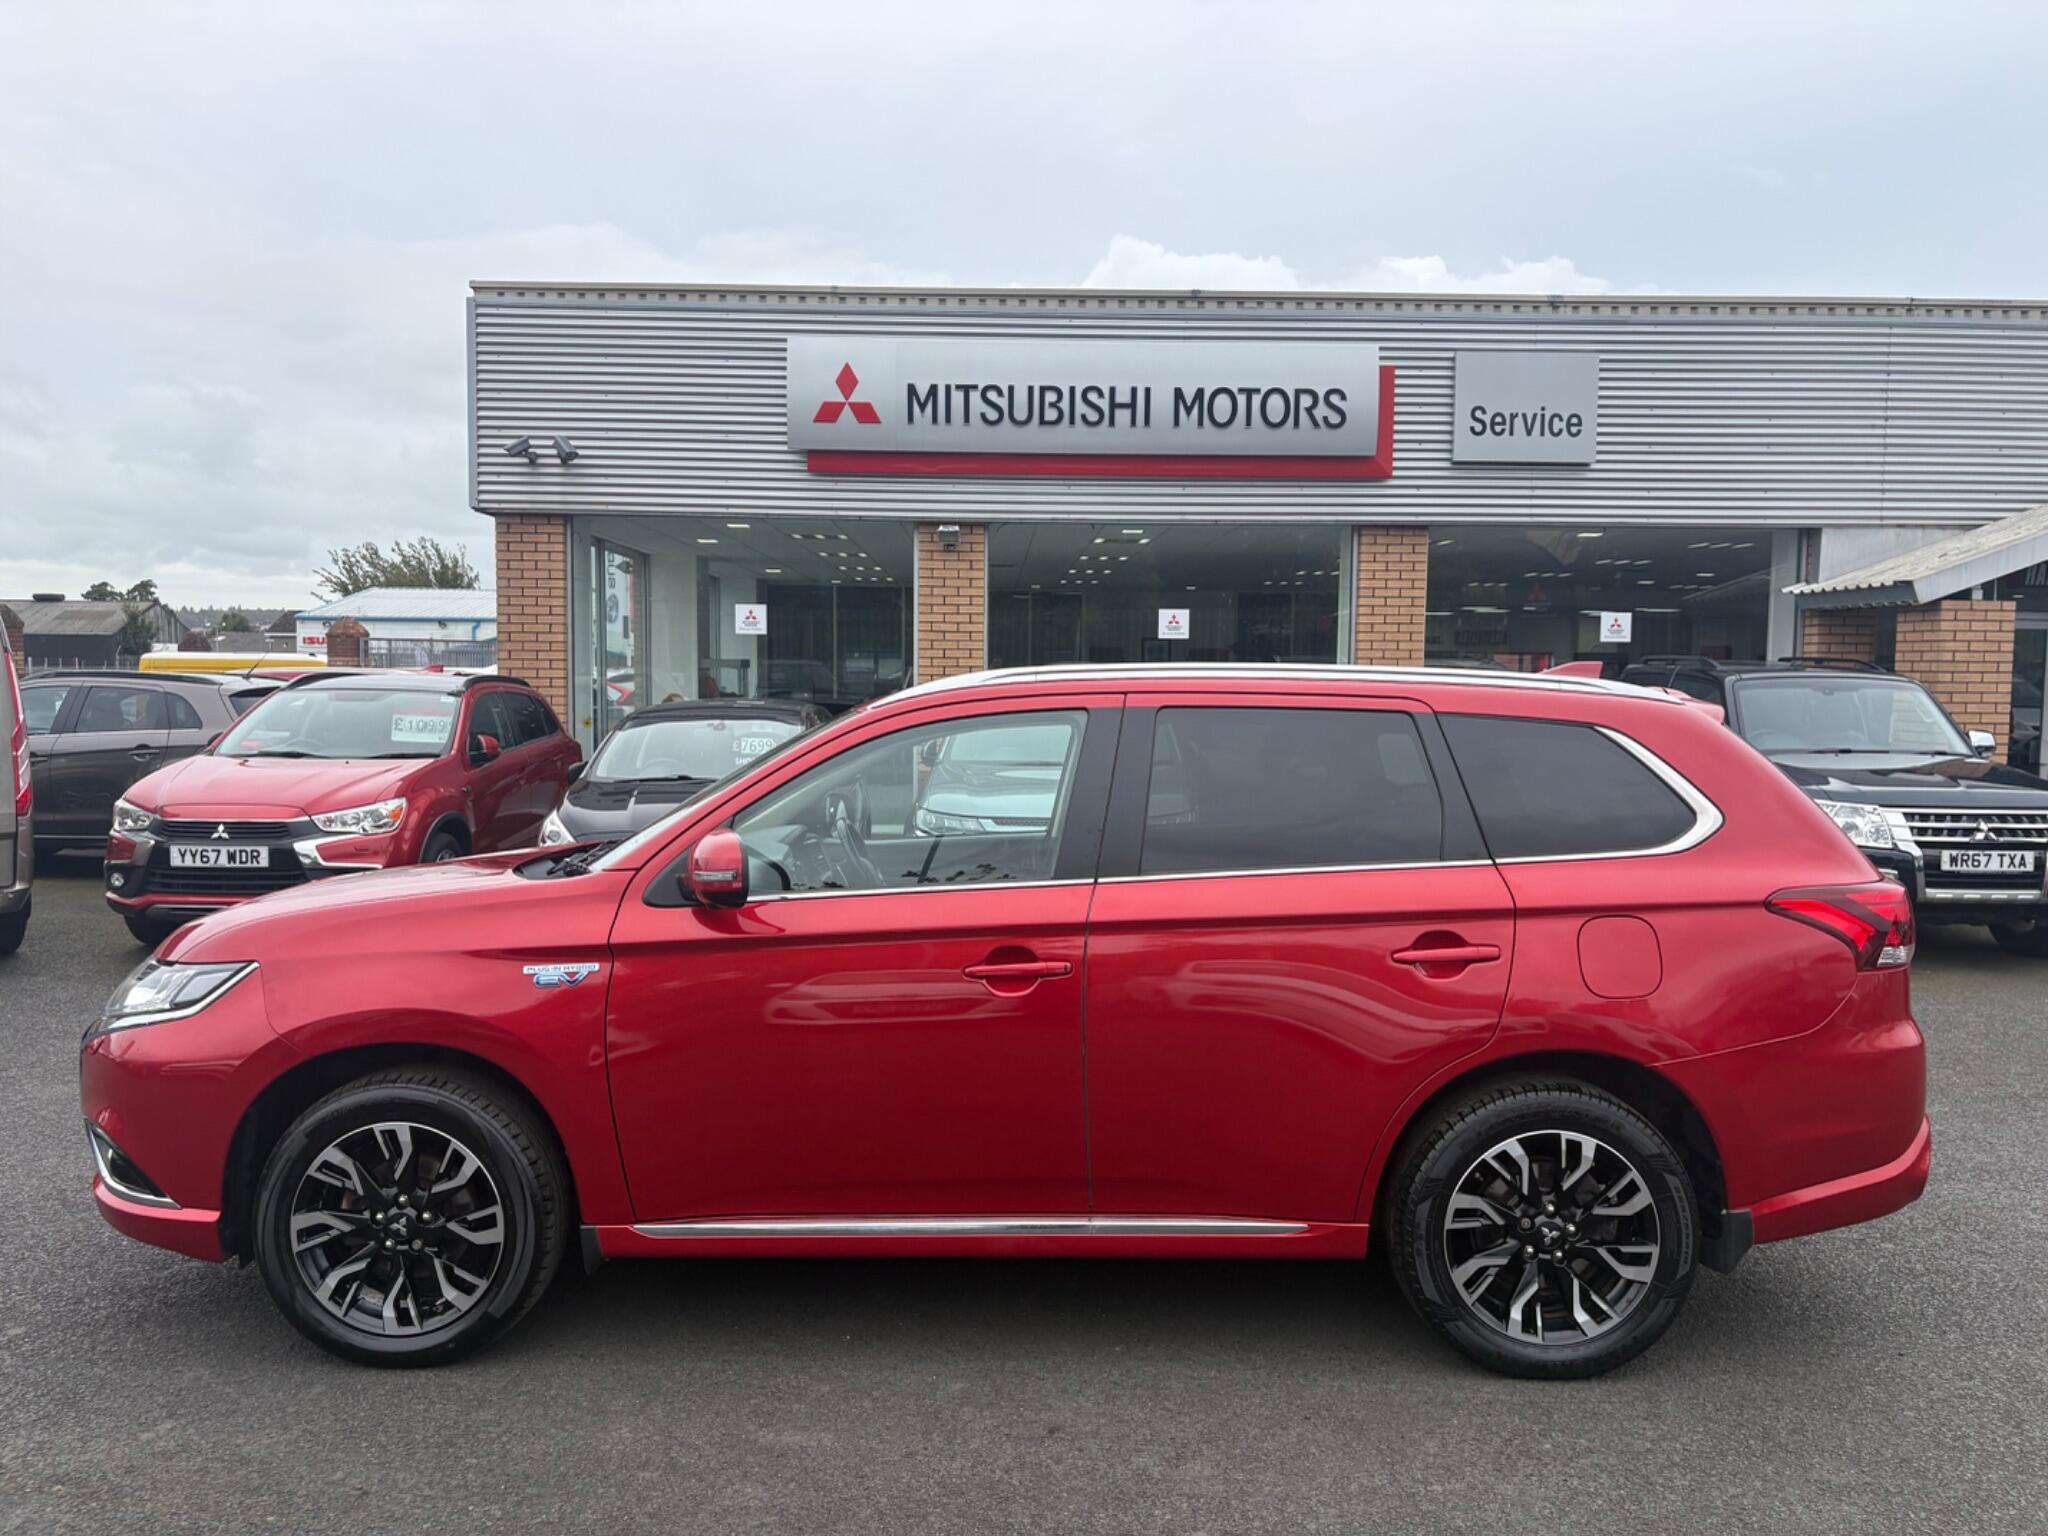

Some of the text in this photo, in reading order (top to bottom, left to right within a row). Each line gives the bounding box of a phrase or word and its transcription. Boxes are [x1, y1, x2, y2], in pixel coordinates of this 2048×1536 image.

[907, 382, 1348, 430] MITSUBISHI MOTORS
[1469, 405, 1583, 438] Service
[2024, 562, 2048, 585] HA
[303, 635, 328, 645] ISU
[178, 848, 260, 865] YY67 WDR
[1949, 853, 2027, 869] WR67 TXA
